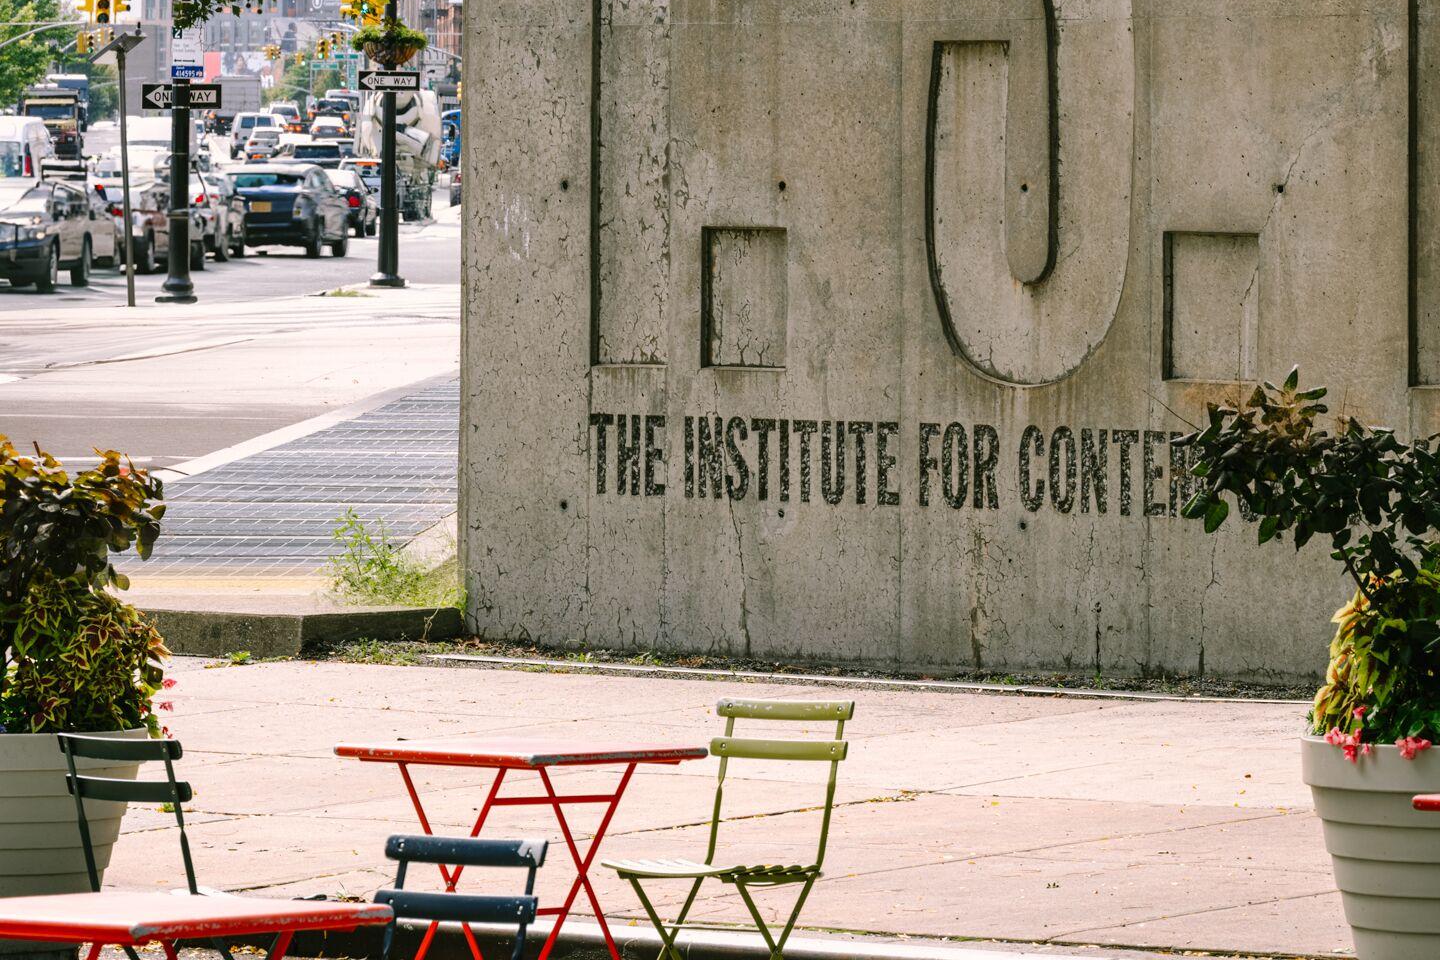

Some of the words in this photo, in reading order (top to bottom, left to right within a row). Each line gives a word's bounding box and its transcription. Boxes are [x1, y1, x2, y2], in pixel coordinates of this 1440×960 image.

[588, 414, 667, 497] THE
[684, 415, 900, 506] INSTITUTE
[918, 422, 1001, 510] FOR
